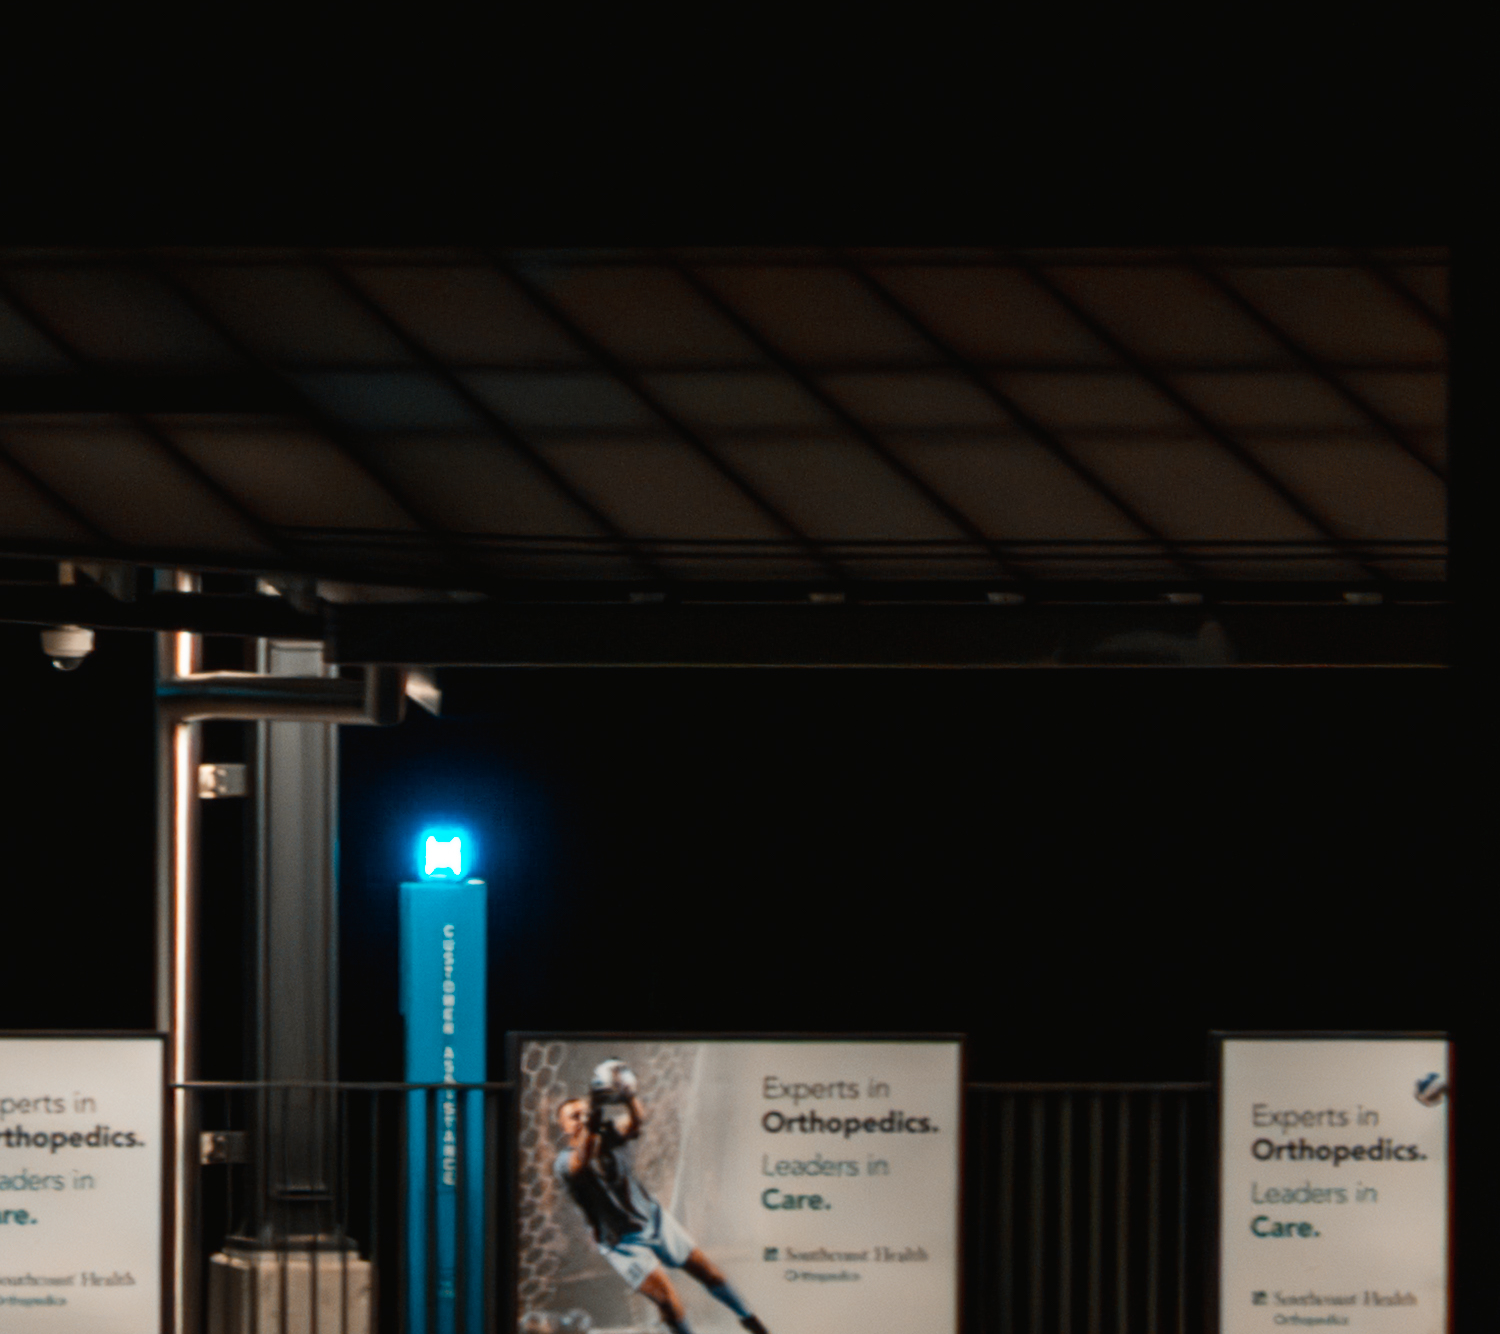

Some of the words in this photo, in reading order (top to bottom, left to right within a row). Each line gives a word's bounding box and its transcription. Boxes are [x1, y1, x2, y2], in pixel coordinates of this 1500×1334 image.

[73, 1091, 96, 1114] in
[760, 1076, 859, 1106] Experts
[867, 1079, 890, 1099] in
[762, 1109, 940, 1139] Orthopedics.
[1252, 1102, 1349, 1135] Experts
[1357, 1104, 1380, 1127] in
[1252, 1137, 1428, 1167] Orthopedics.
[762, 1153, 860, 1177] Leaders
[867, 1153, 890, 1176] in
[73, 1169, 95, 1190] in
[761, 1187, 832, 1210] Care.
[1251, 1181, 1349, 1205] Leaders
[1356, 1180, 1379, 1204] in
[1251, 1214, 1322, 1238] Care.
